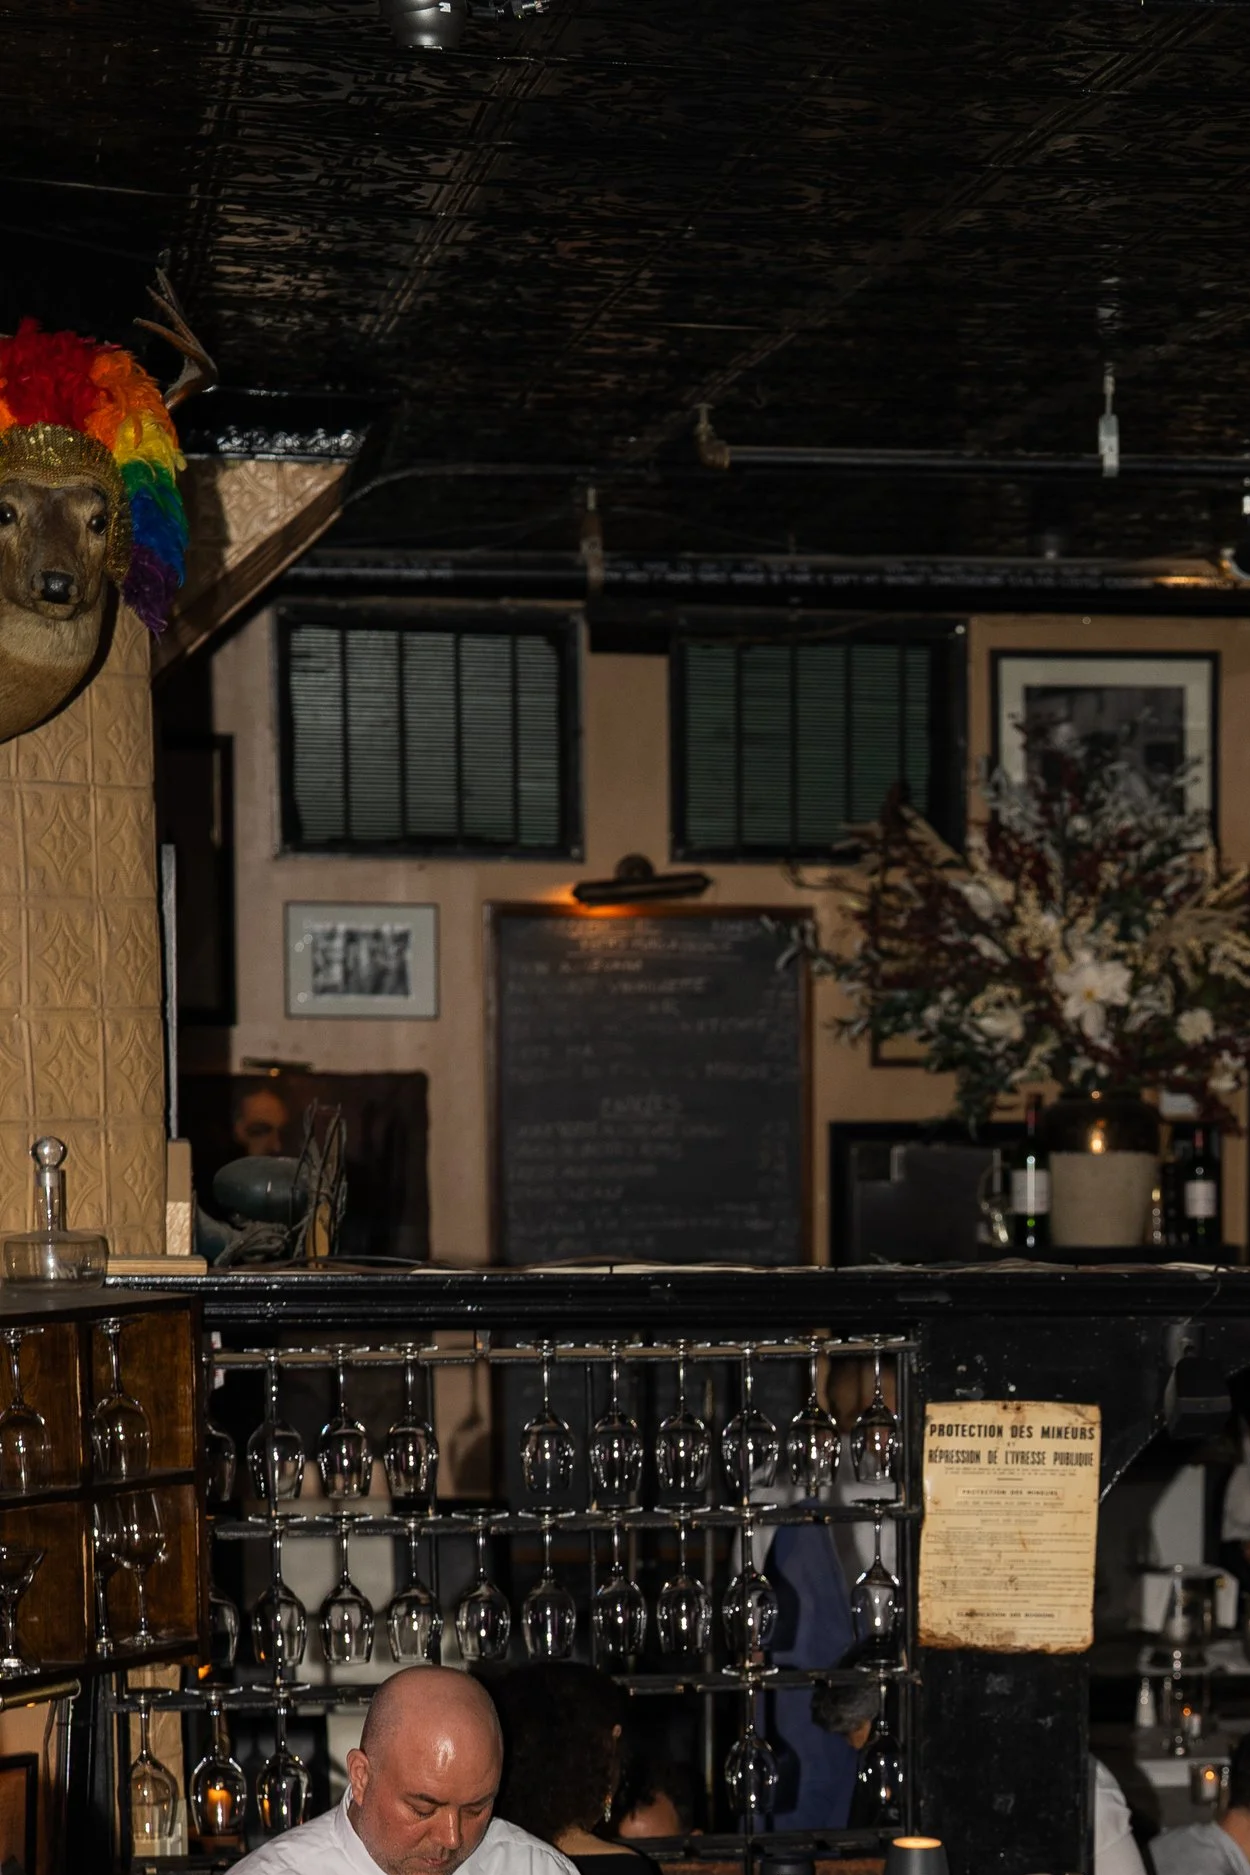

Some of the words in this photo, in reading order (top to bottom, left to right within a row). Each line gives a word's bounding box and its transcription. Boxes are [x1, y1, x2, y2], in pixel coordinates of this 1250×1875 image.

[929, 1423, 1004, 1438] PROTECTION
[1010, 1425, 1034, 1439] DES
[1040, 1425, 1096, 1440] MINEURS
[927, 1446, 982, 1464] RÉPRESSION
[1004, 1450, 1047, 1466] L'IVRESSE
[1053, 1451, 1094, 1468] PUBLIQUE
